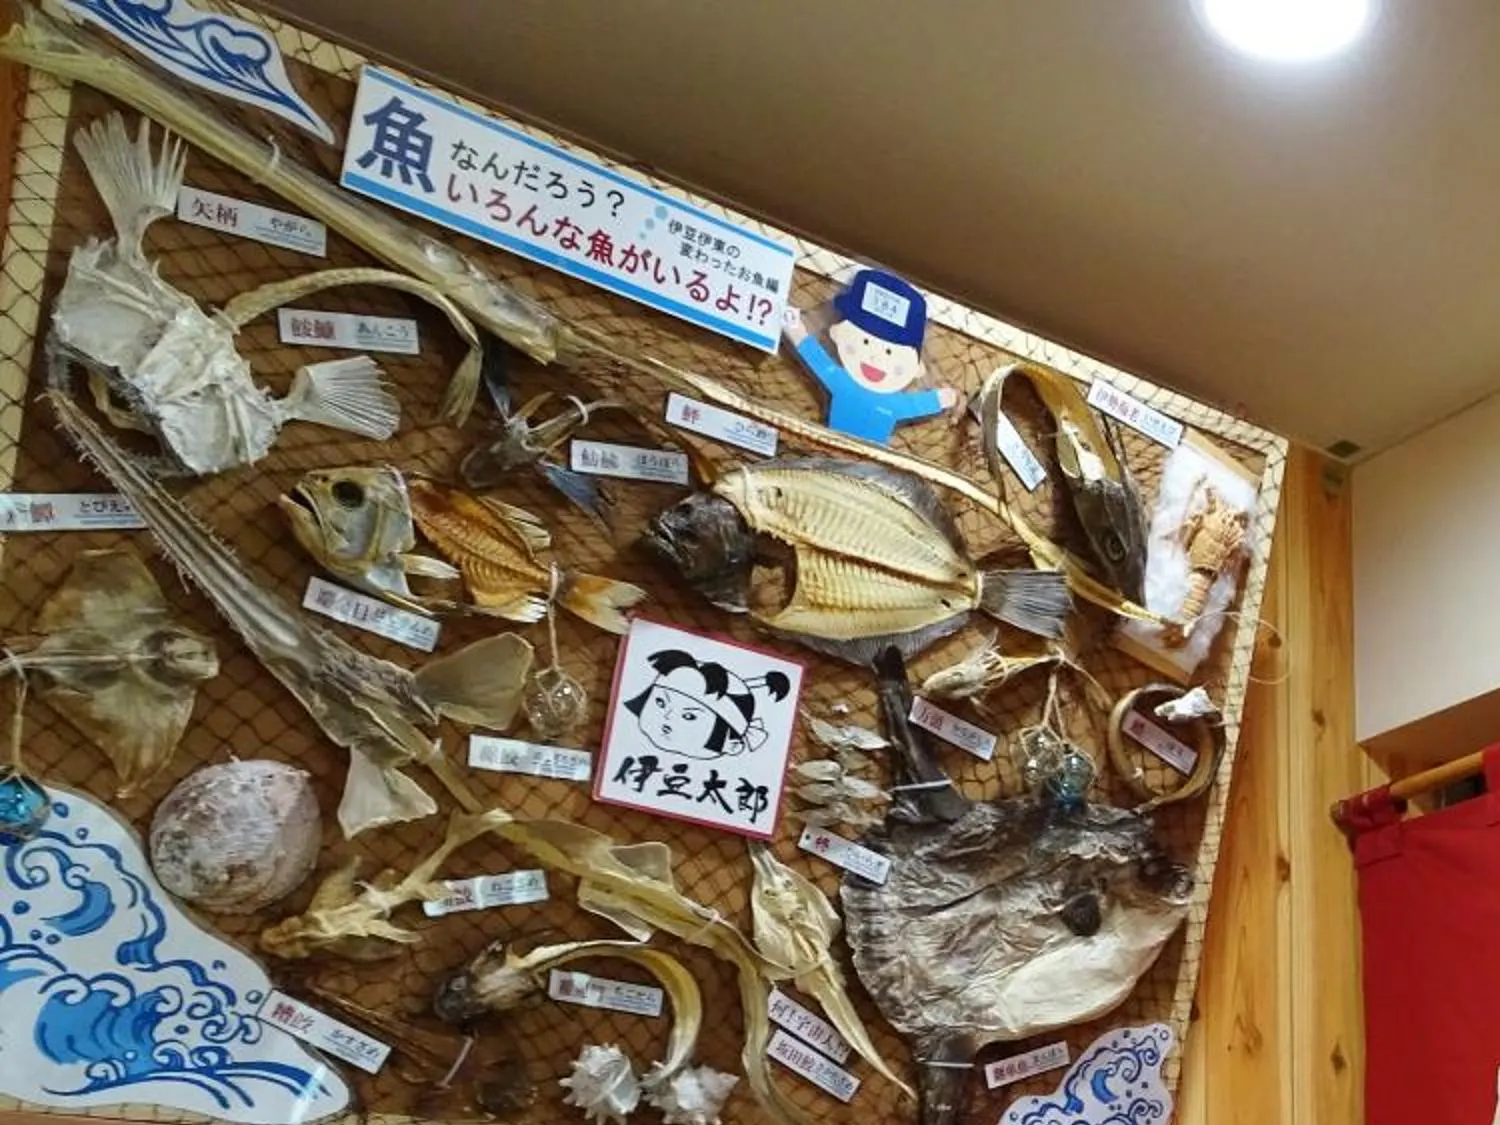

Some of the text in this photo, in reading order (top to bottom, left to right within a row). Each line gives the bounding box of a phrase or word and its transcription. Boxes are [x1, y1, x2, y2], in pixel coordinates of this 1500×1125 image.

[356, 96, 437, 194] 魚
[449, 139, 626, 219] なんだろう?
[667, 217, 742, 260] 伊豆伊東の
[678, 242, 780, 294] 変わったお魚編
[356, 321, 411, 338] あんこう
[612, 754, 771, 826] 伊豆太郎
